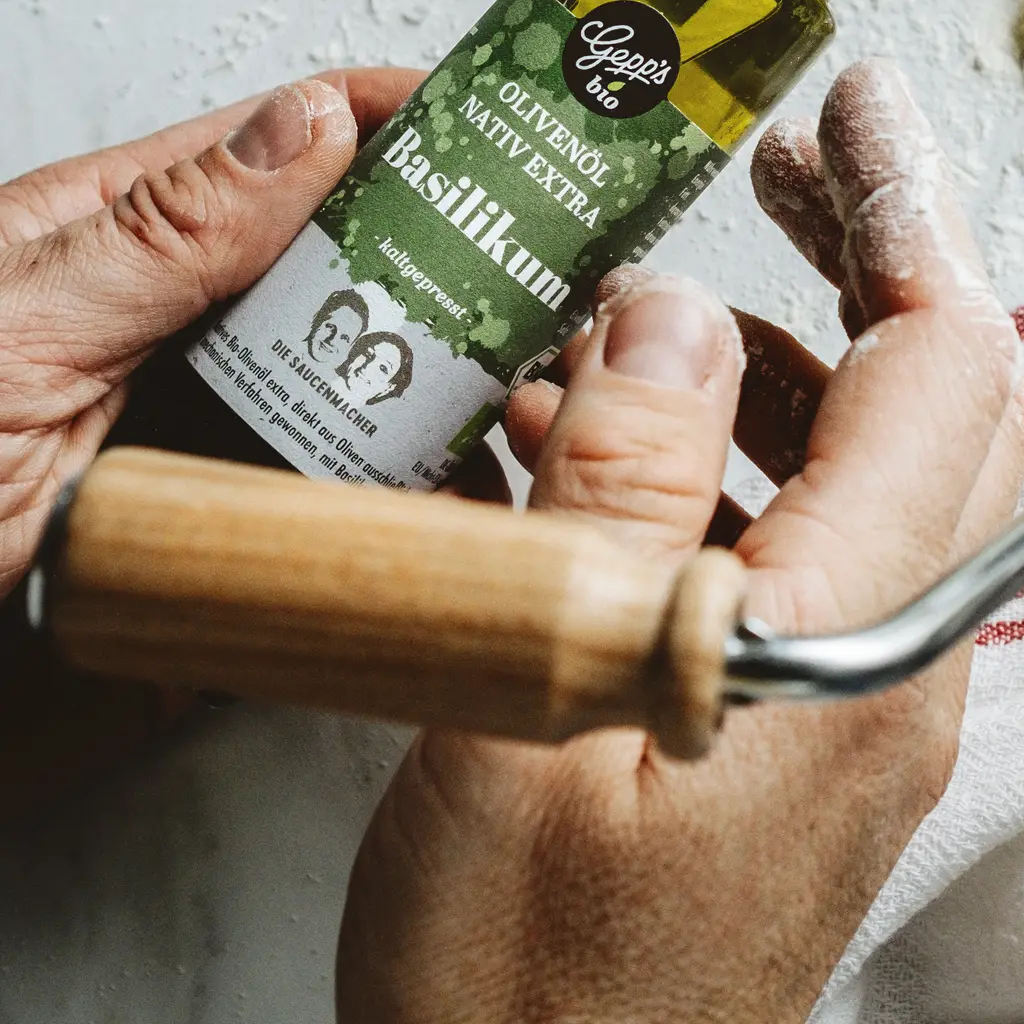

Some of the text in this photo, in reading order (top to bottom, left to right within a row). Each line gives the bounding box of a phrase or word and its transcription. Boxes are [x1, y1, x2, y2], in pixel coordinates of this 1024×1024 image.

[575, 20, 672, 85] Gepp's
[586, 74, 621, 110] bio
[458, 94, 601, 229] NATIV EXTRA
[499, 81, 611, 188] OLIVENÖL
[382, 125, 571, 312] Basilikum
[378, 237, 467, 320] kaltgepresst
[227, 335, 272, 382] Bio-Olivenöl
[266, 377, 290, 407] extra,
[291, 400, 322, 429] direkt
[318, 426, 336, 444] aus
[336, 438, 364, 467] Oliven
[233, 371, 273, 415] Verfahren
[269, 411, 318, 458] gewonnen,
[319, 453, 338, 471] mit
[271, 339, 378, 438] DIE SAUCENMACHER
